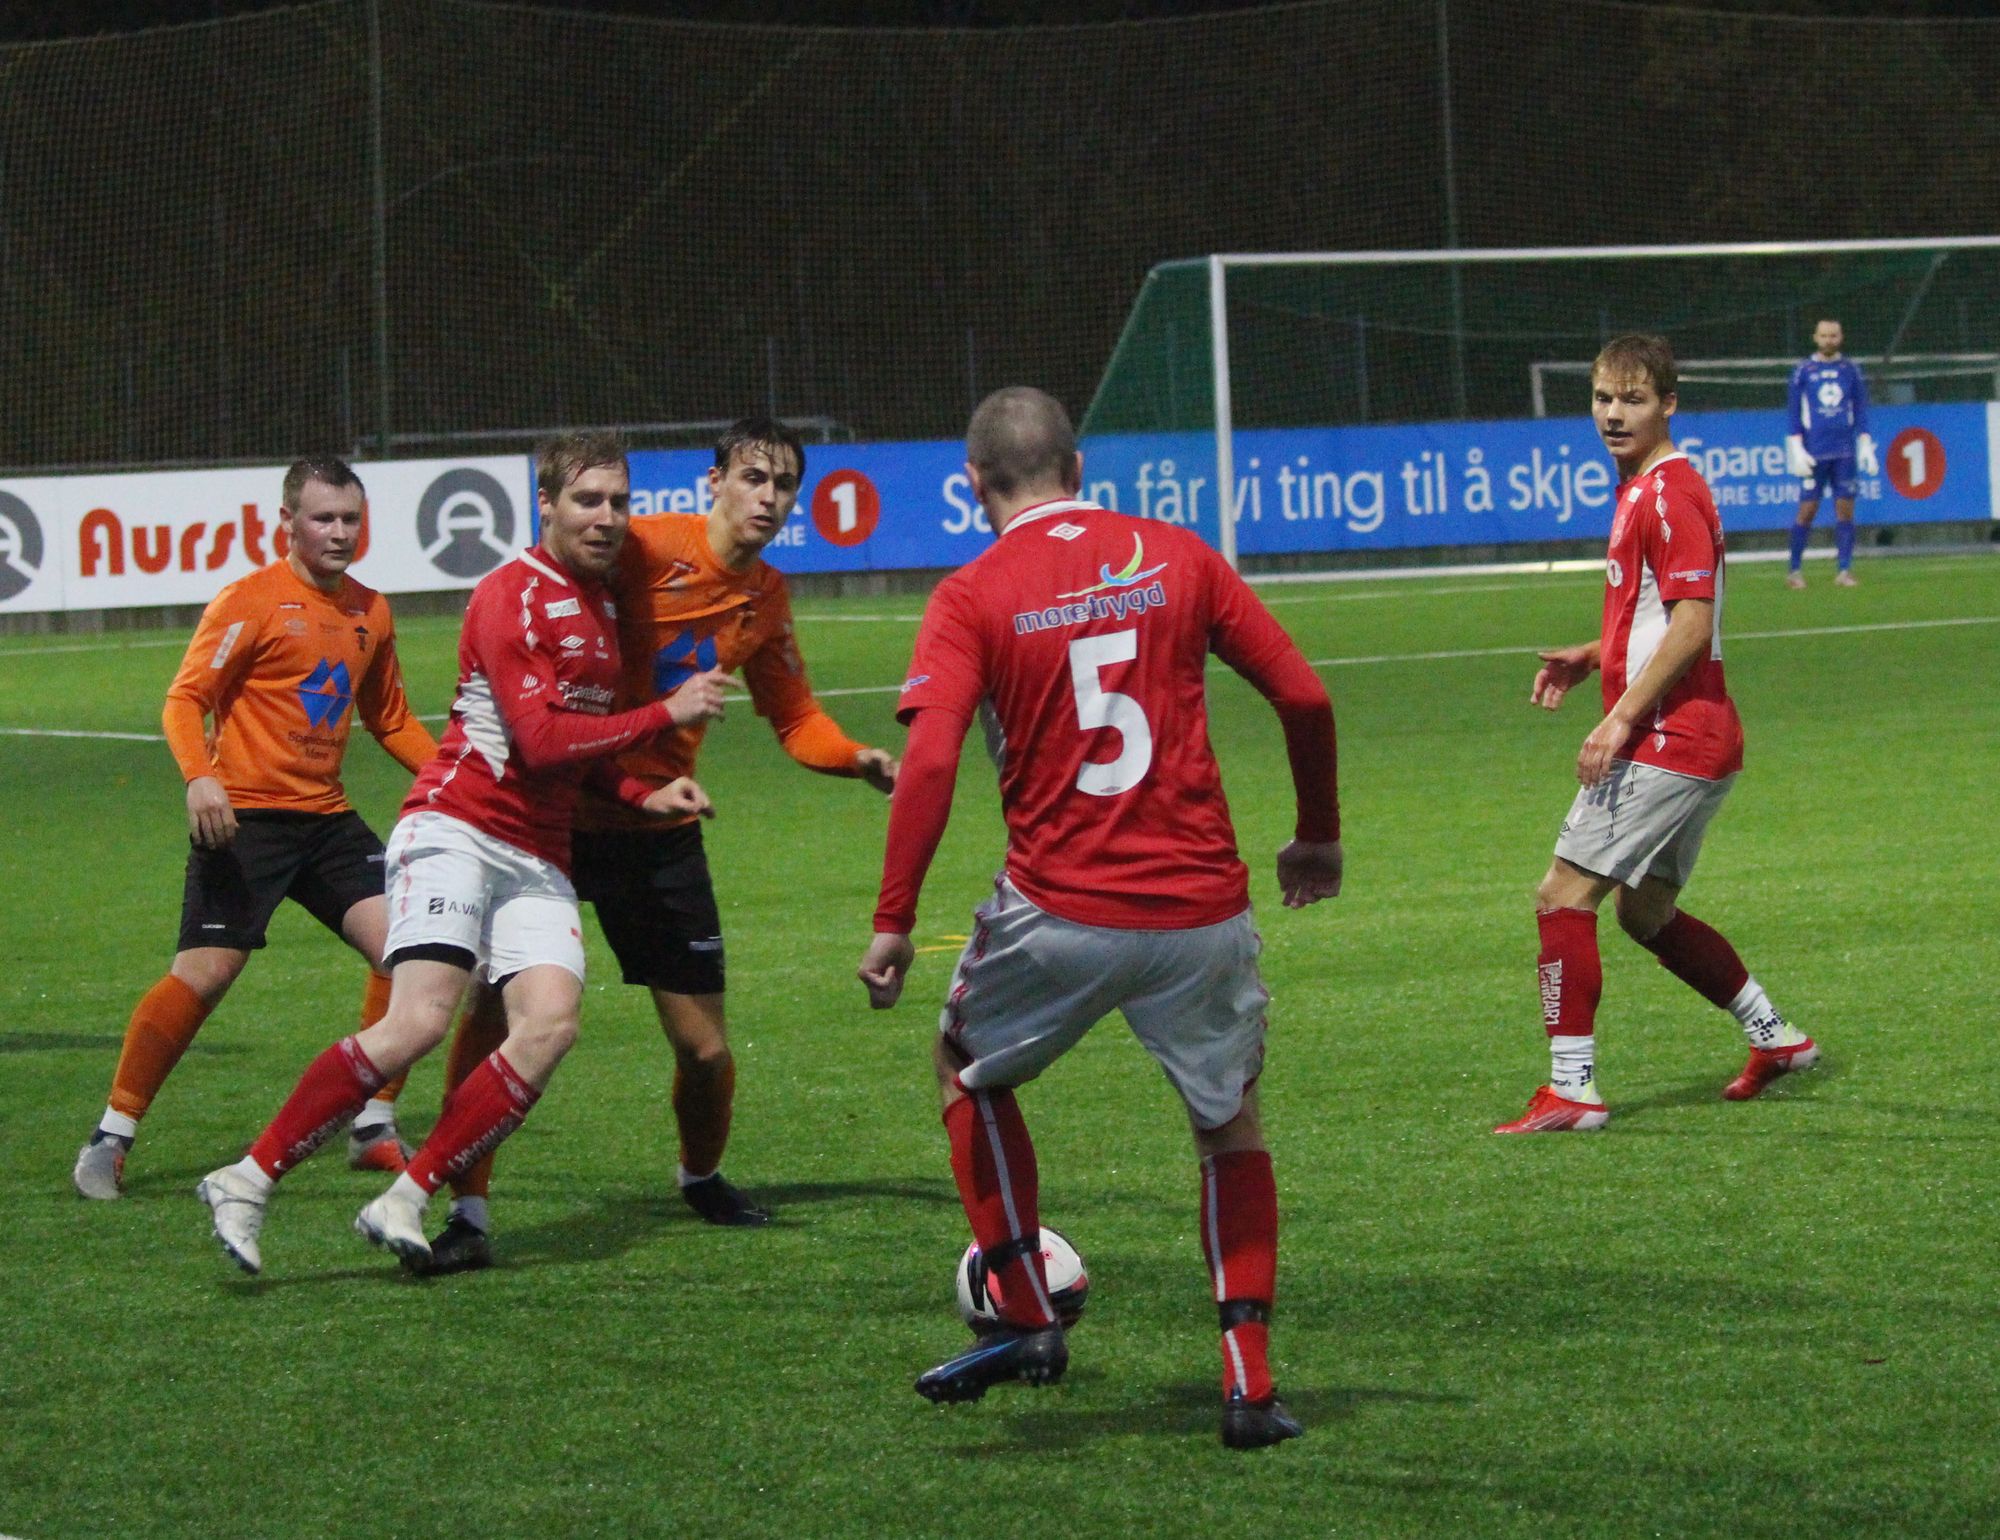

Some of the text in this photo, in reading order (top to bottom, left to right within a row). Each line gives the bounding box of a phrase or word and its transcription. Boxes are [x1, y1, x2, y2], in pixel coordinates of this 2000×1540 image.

[1136, 459, 1205, 524] får
[1278, 456, 1385, 532] ting
[1401, 450, 1448, 516] til
[1463, 447, 1494, 513] å
[1508, 444, 1610, 523] skje
[79, 502, 370, 578] Aurst
[1014, 581, 1168, 635] møretrygd
[1068, 628, 1153, 797] 5
